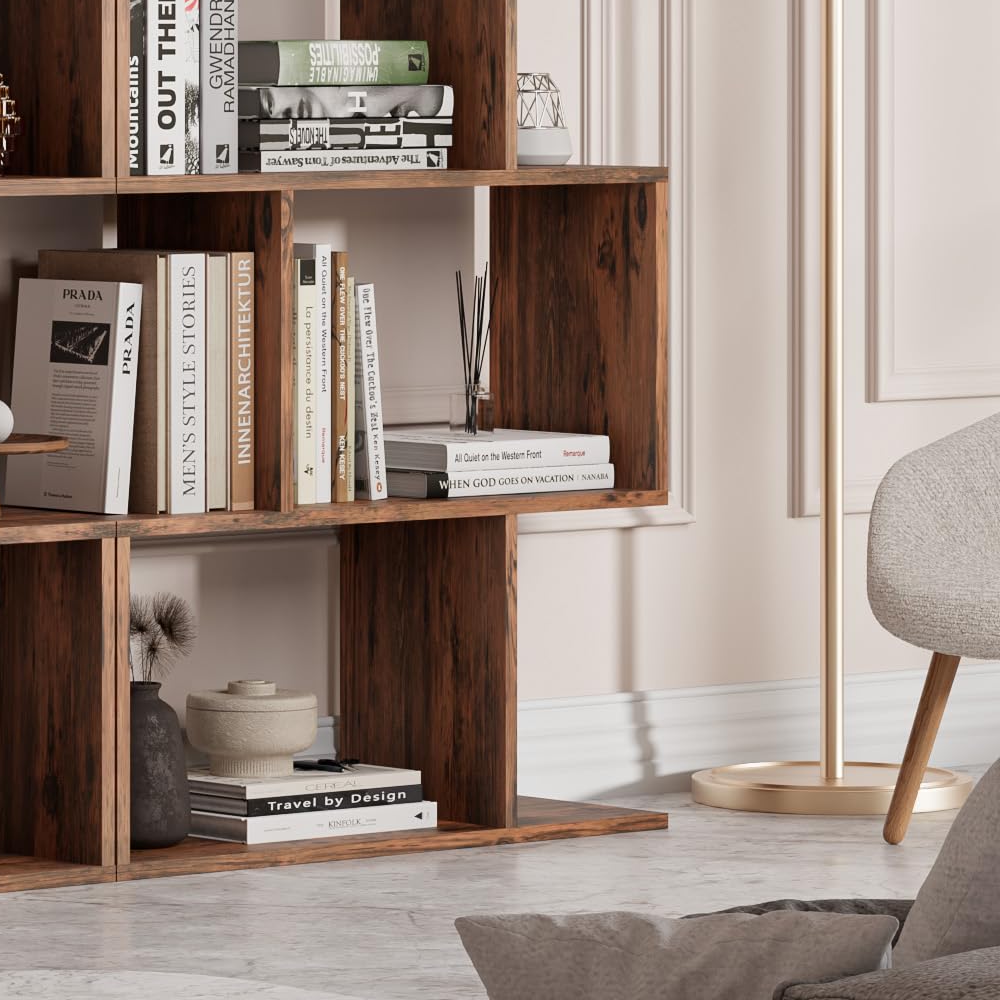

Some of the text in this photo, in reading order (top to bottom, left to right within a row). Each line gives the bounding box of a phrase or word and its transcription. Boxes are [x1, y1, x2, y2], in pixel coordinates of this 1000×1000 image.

[309, 43, 380, 66] POSSIBILITIES
[309, 66, 378, 82] UNIMAGINABLE
[157, 70, 176, 130] OUT
[315, 127, 327, 145] THE
[266, 154, 421, 167] The Adventures of Tom Sawyer
[62, 288, 103, 301] PRADA
[321, 297, 328, 309] on
[121, 302, 135, 375] PRADA
[237, 259, 251, 464] INNENARCHITEKTUR
[366, 352, 375, 369] The
[304, 306, 314, 439] La persistance du destin
[182, 266, 196, 497] MEN'S STYLE STORIES
[454, 449, 542, 464] All Quiet on the Western Front
[438, 474, 574, 490] WHEN GOD GOES ON VACATION
[267, 790, 406, 811] Travel by Design
[328, 818, 361, 828] KINFOLK
